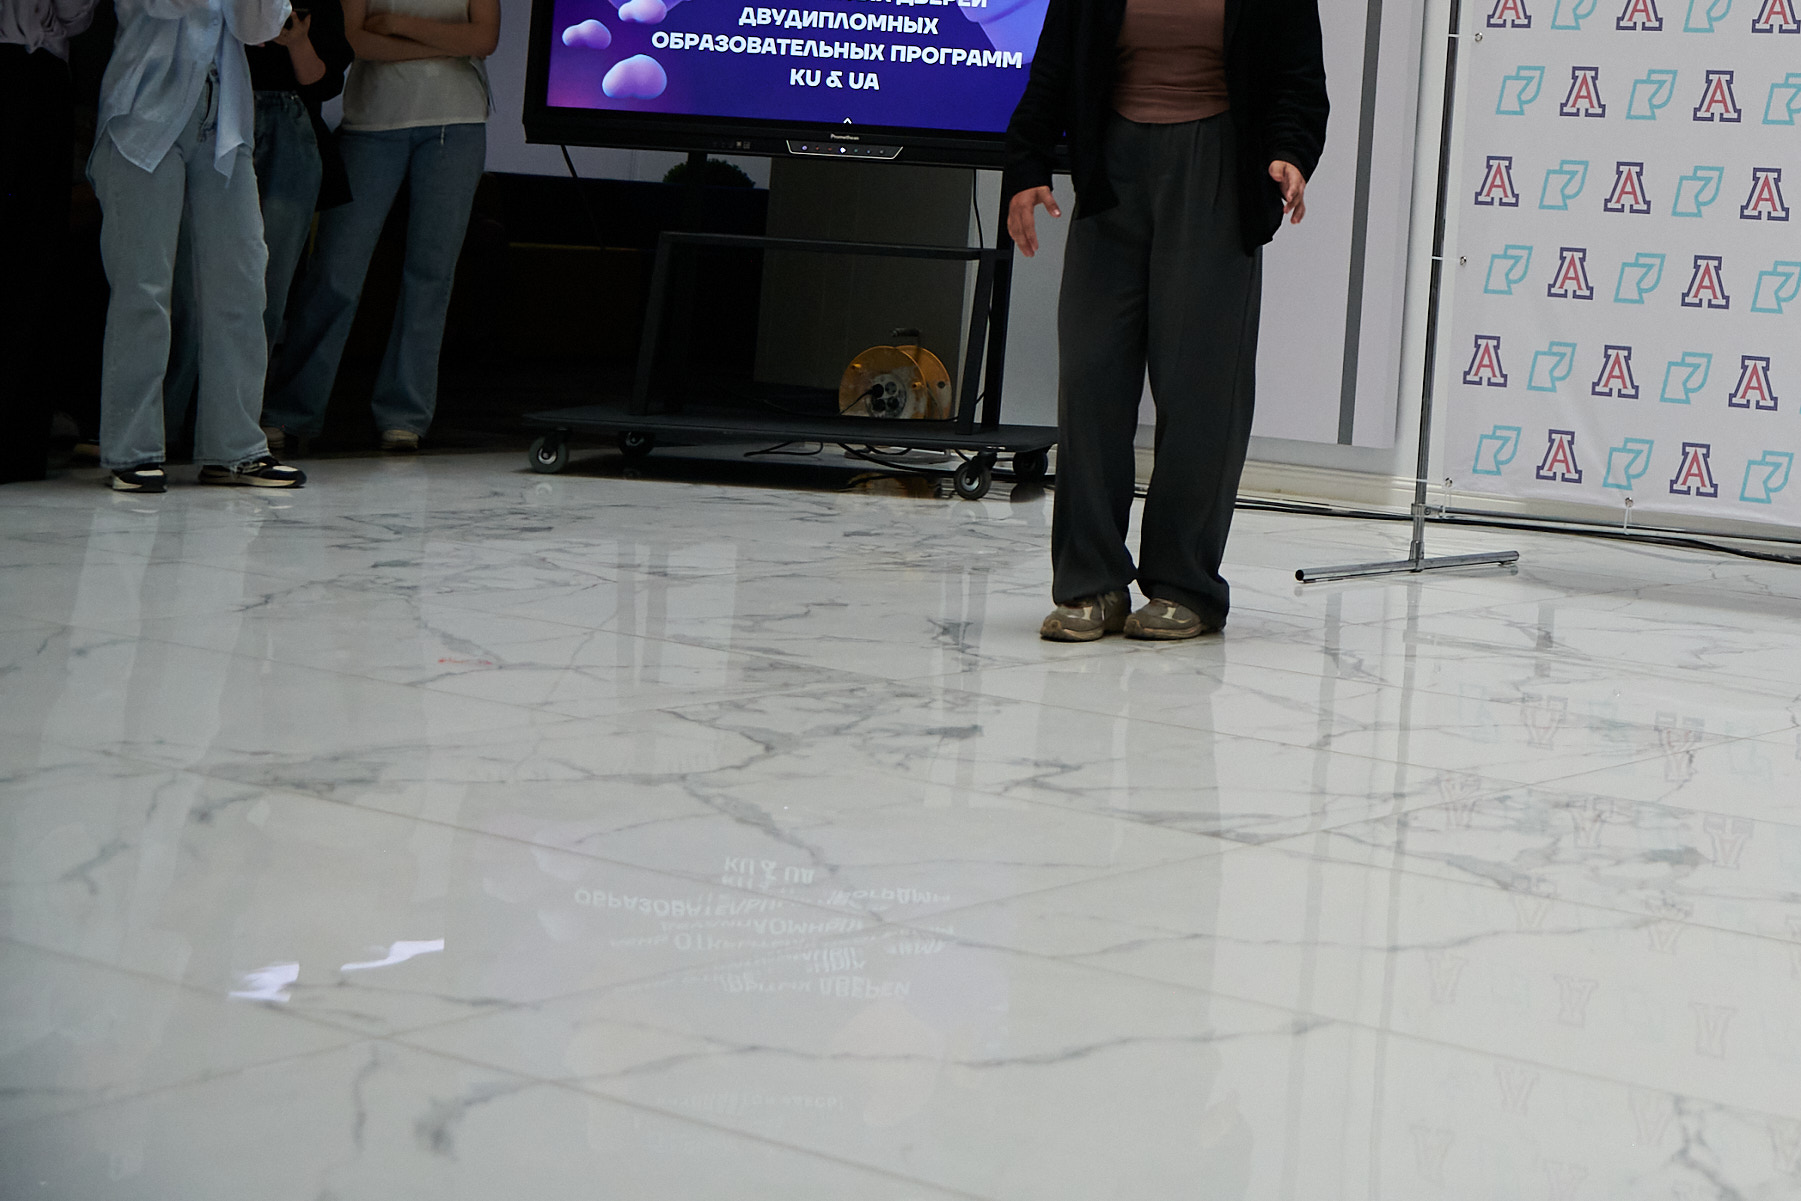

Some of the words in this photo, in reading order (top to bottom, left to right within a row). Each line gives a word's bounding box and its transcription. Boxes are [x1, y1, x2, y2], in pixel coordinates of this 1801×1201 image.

[739, 7, 939, 35] ДВУДИПЛОМНЫХ
[651, 31, 884, 61] ОБРАЗОВАТЕЛЬНЫХ
[891, 45, 1023, 69] ПРОГРАММ
[790, 68, 821, 87] KU
[826, 71, 843, 88] &
[849, 72, 880, 90] UA
[1560, 66, 1605, 117] A
[1693, 70, 1741, 122] A
[1475, 156, 1519, 206] A
[1605, 162, 1651, 213] A
[1740, 168, 1789, 221] A
[1548, 247, 1593, 299] A
[1682, 255, 1729, 309] A
[1464, 335, 1507, 387] A
[1592, 345, 1639, 398] A
[1729, 355, 1777, 410] A
[1536, 430, 1582, 483] A
[1670, 442, 1718, 497] A
